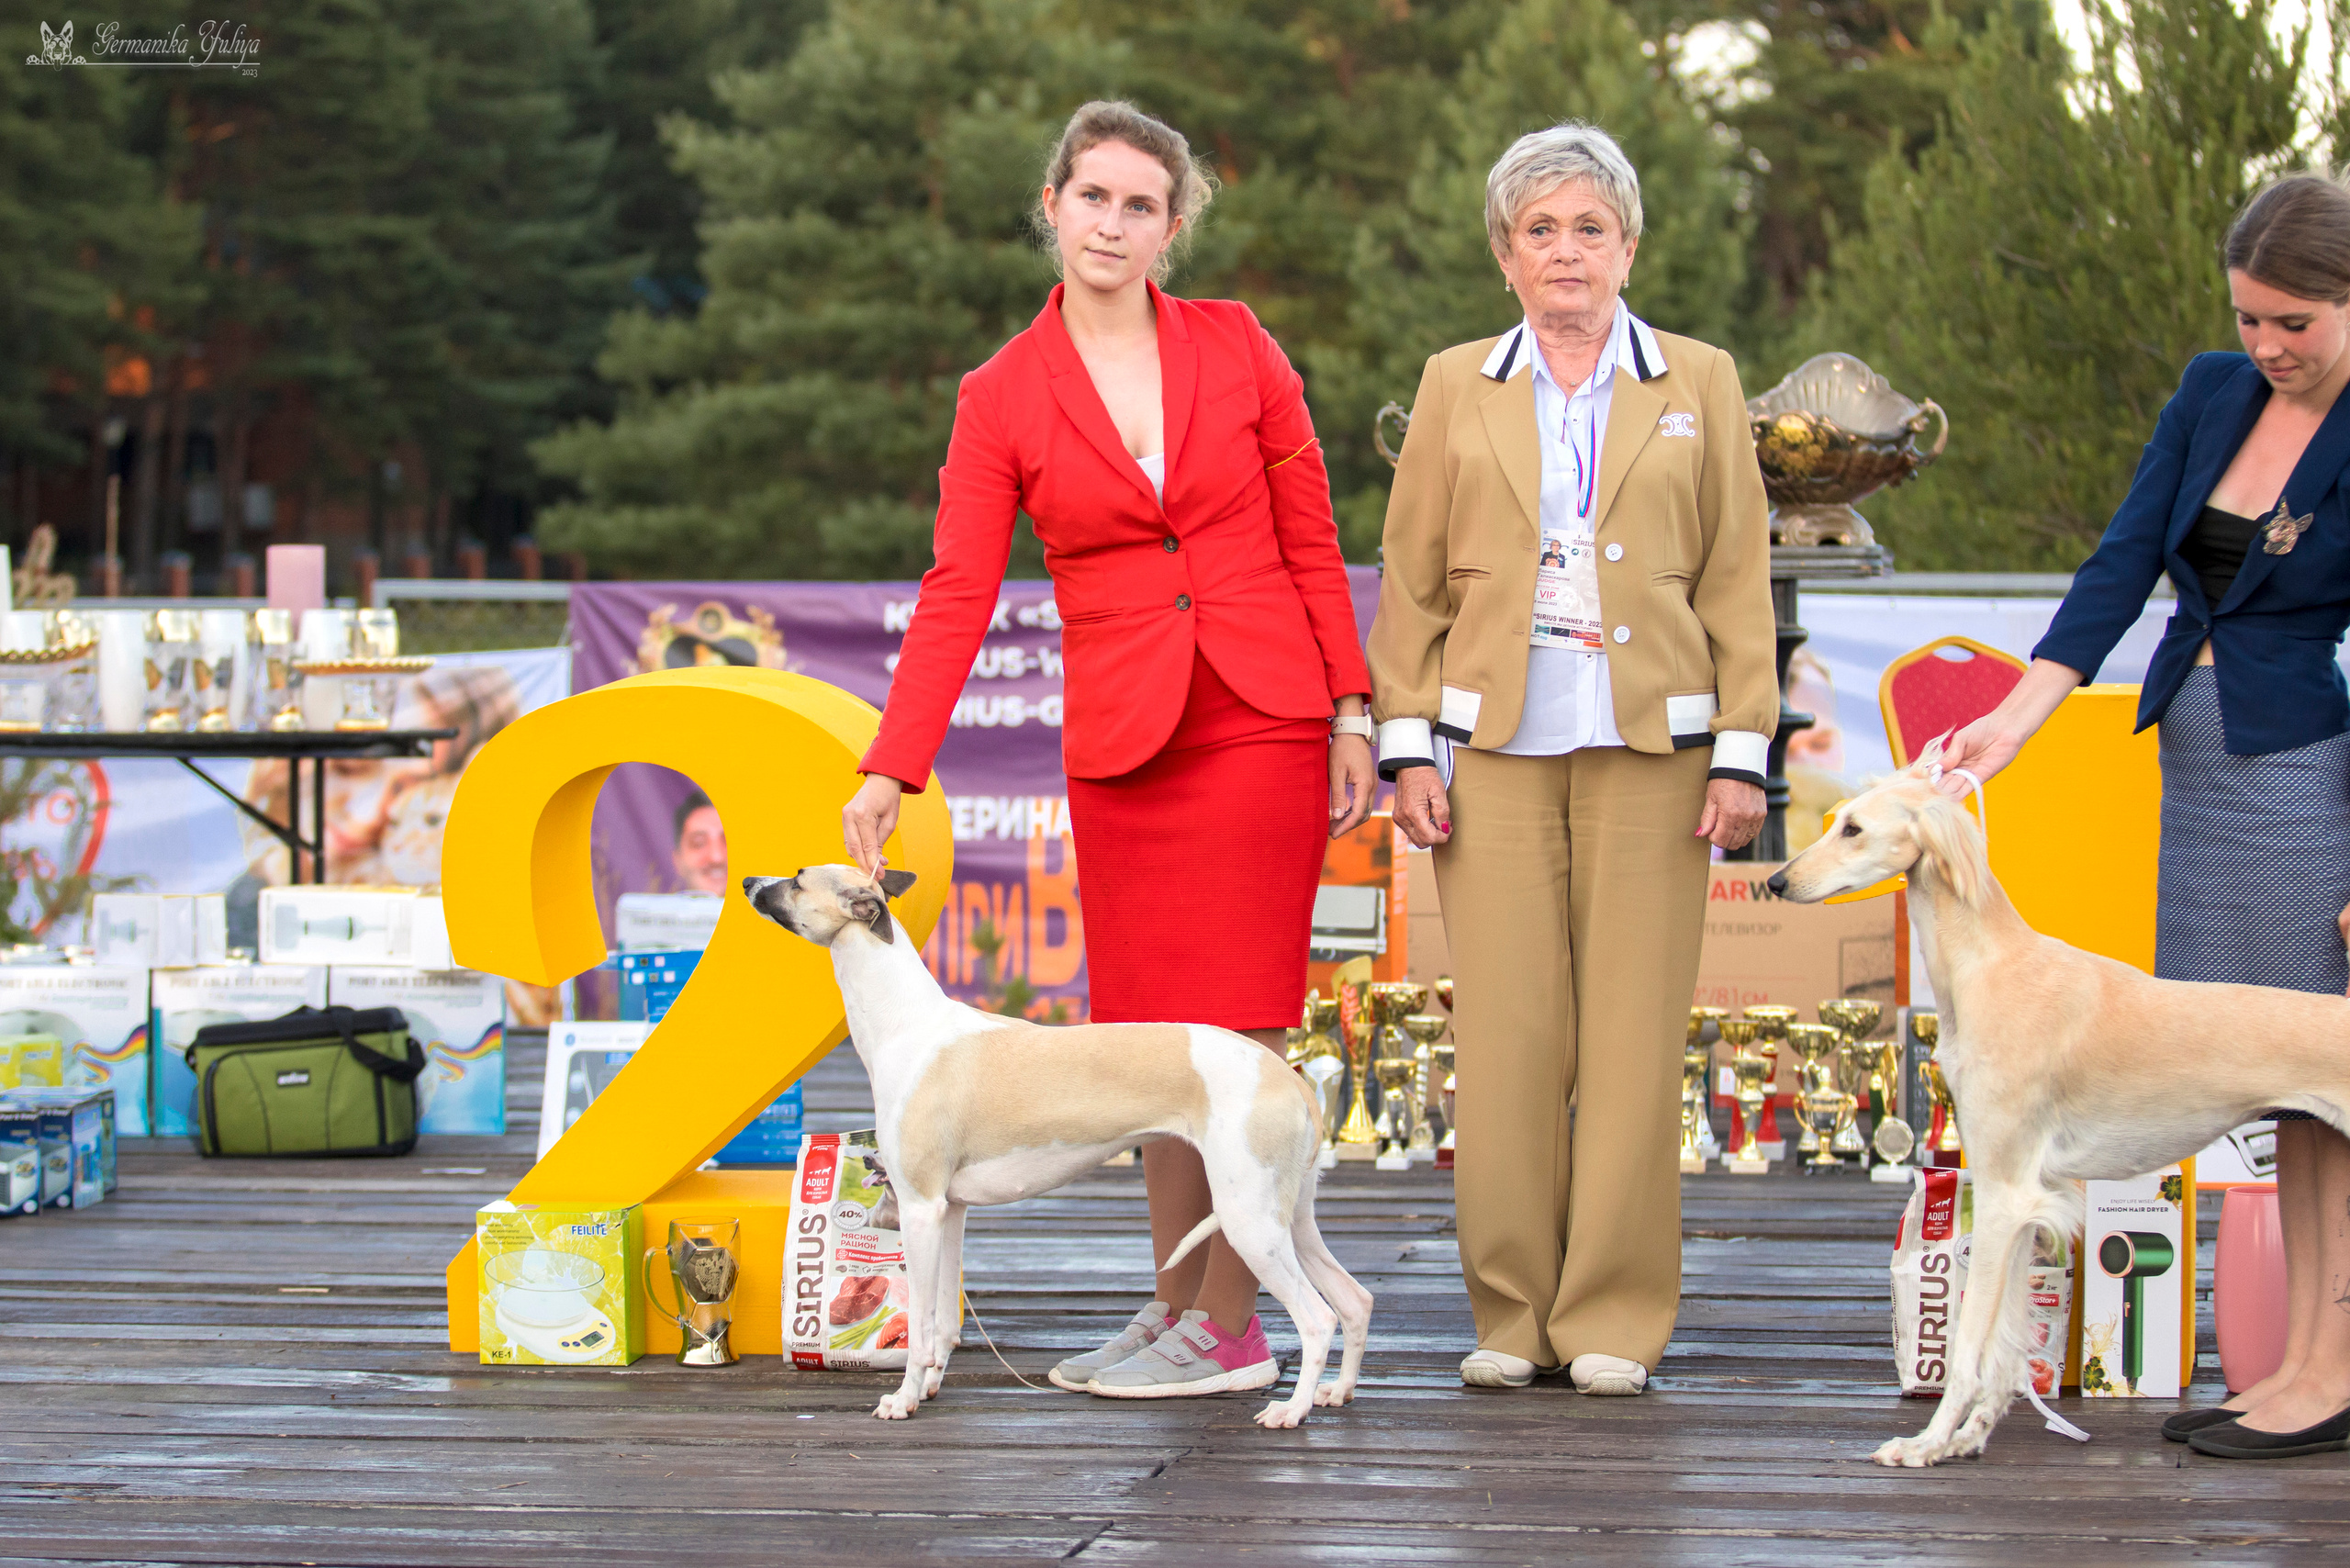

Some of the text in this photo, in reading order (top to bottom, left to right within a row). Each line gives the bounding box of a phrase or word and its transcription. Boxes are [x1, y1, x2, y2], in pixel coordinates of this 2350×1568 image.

[1539, 589, 1557, 599] VIP
[1559, 616, 1583, 625] WINNER
[805, 1177, 830, 1187] ADULT
[838, 1210, 863, 1218] 40%
[1927, 1211, 1950, 1221] ADULT
[571, 1224, 608, 1236] FEILITE
[841, 1232, 879, 1243] МЯСНОЙ
[840, 1239, 877, 1249] РАЦИОН
[848, 1251, 870, 1260] Комплекс
[793, 1214, 827, 1338] SIRIUS
[1916, 1253, 1951, 1383] SIRIUS
[492, 1350, 511, 1359] KE-1
[796, 1357, 819, 1365] ADULT
[830, 1360, 869, 1368] SIRIUS
